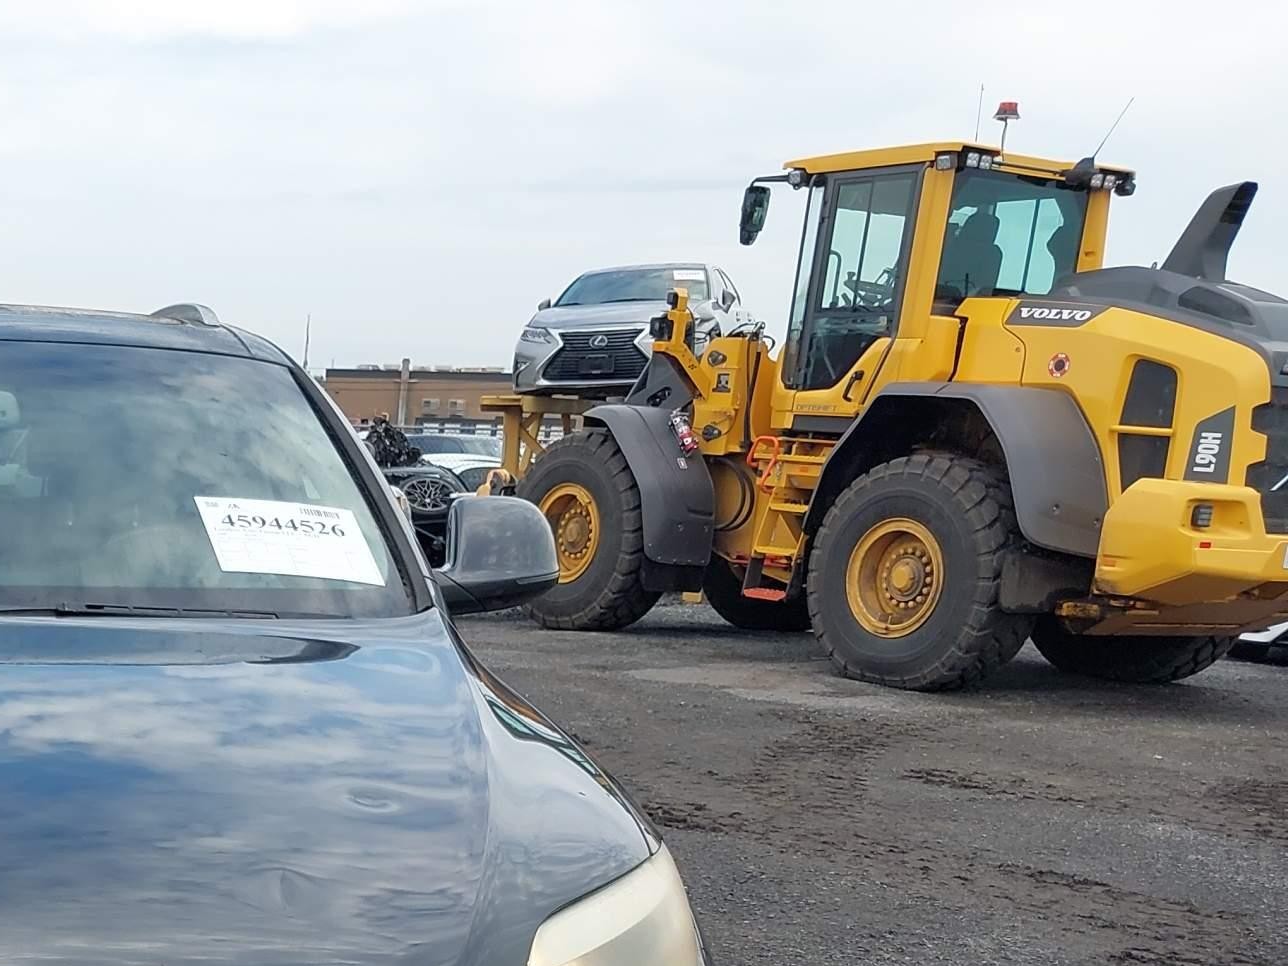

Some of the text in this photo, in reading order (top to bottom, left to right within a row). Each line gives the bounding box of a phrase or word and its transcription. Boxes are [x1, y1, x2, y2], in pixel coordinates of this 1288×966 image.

[1019, 307, 1092, 321] VOLVO
[1192, 432, 1223, 473] L90H
[221, 513, 346, 537] 45944526
